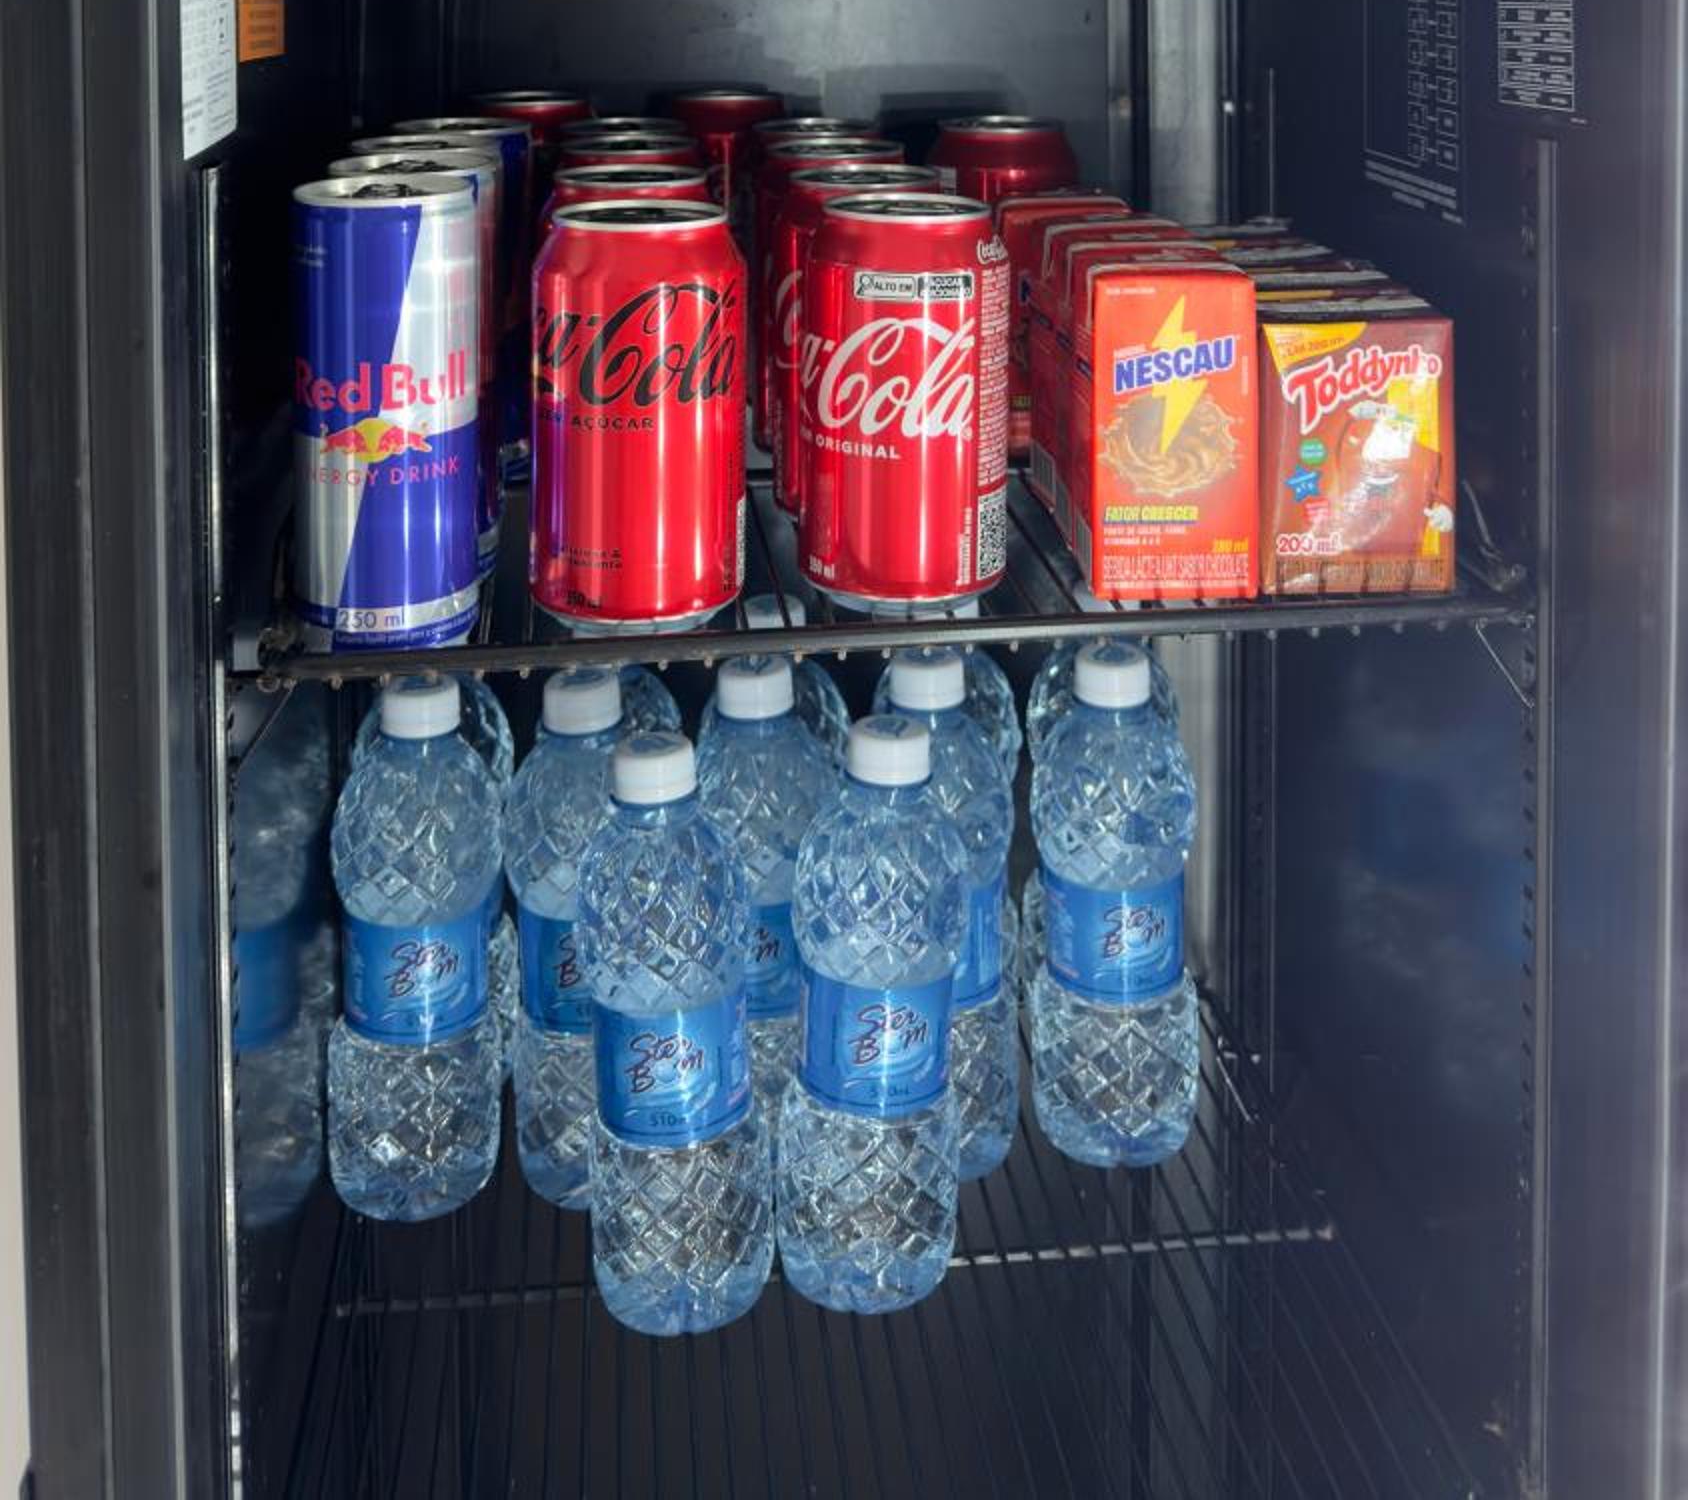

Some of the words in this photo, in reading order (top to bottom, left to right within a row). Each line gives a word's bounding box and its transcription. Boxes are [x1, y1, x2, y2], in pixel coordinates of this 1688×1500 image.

[1114, 336, 1234, 392] NESCAU
[294, 355, 371, 413] Red
[381, 348, 467, 411] Bull
[571, 413, 655, 431] AÇÚCAR
[815, 430, 901, 460] ORIGINAL
[389, 455, 460, 486] DRINK
[1279, 536, 1313, 553] 200
[338, 611, 377, 629] 250
[384, 608, 405, 628] ml
